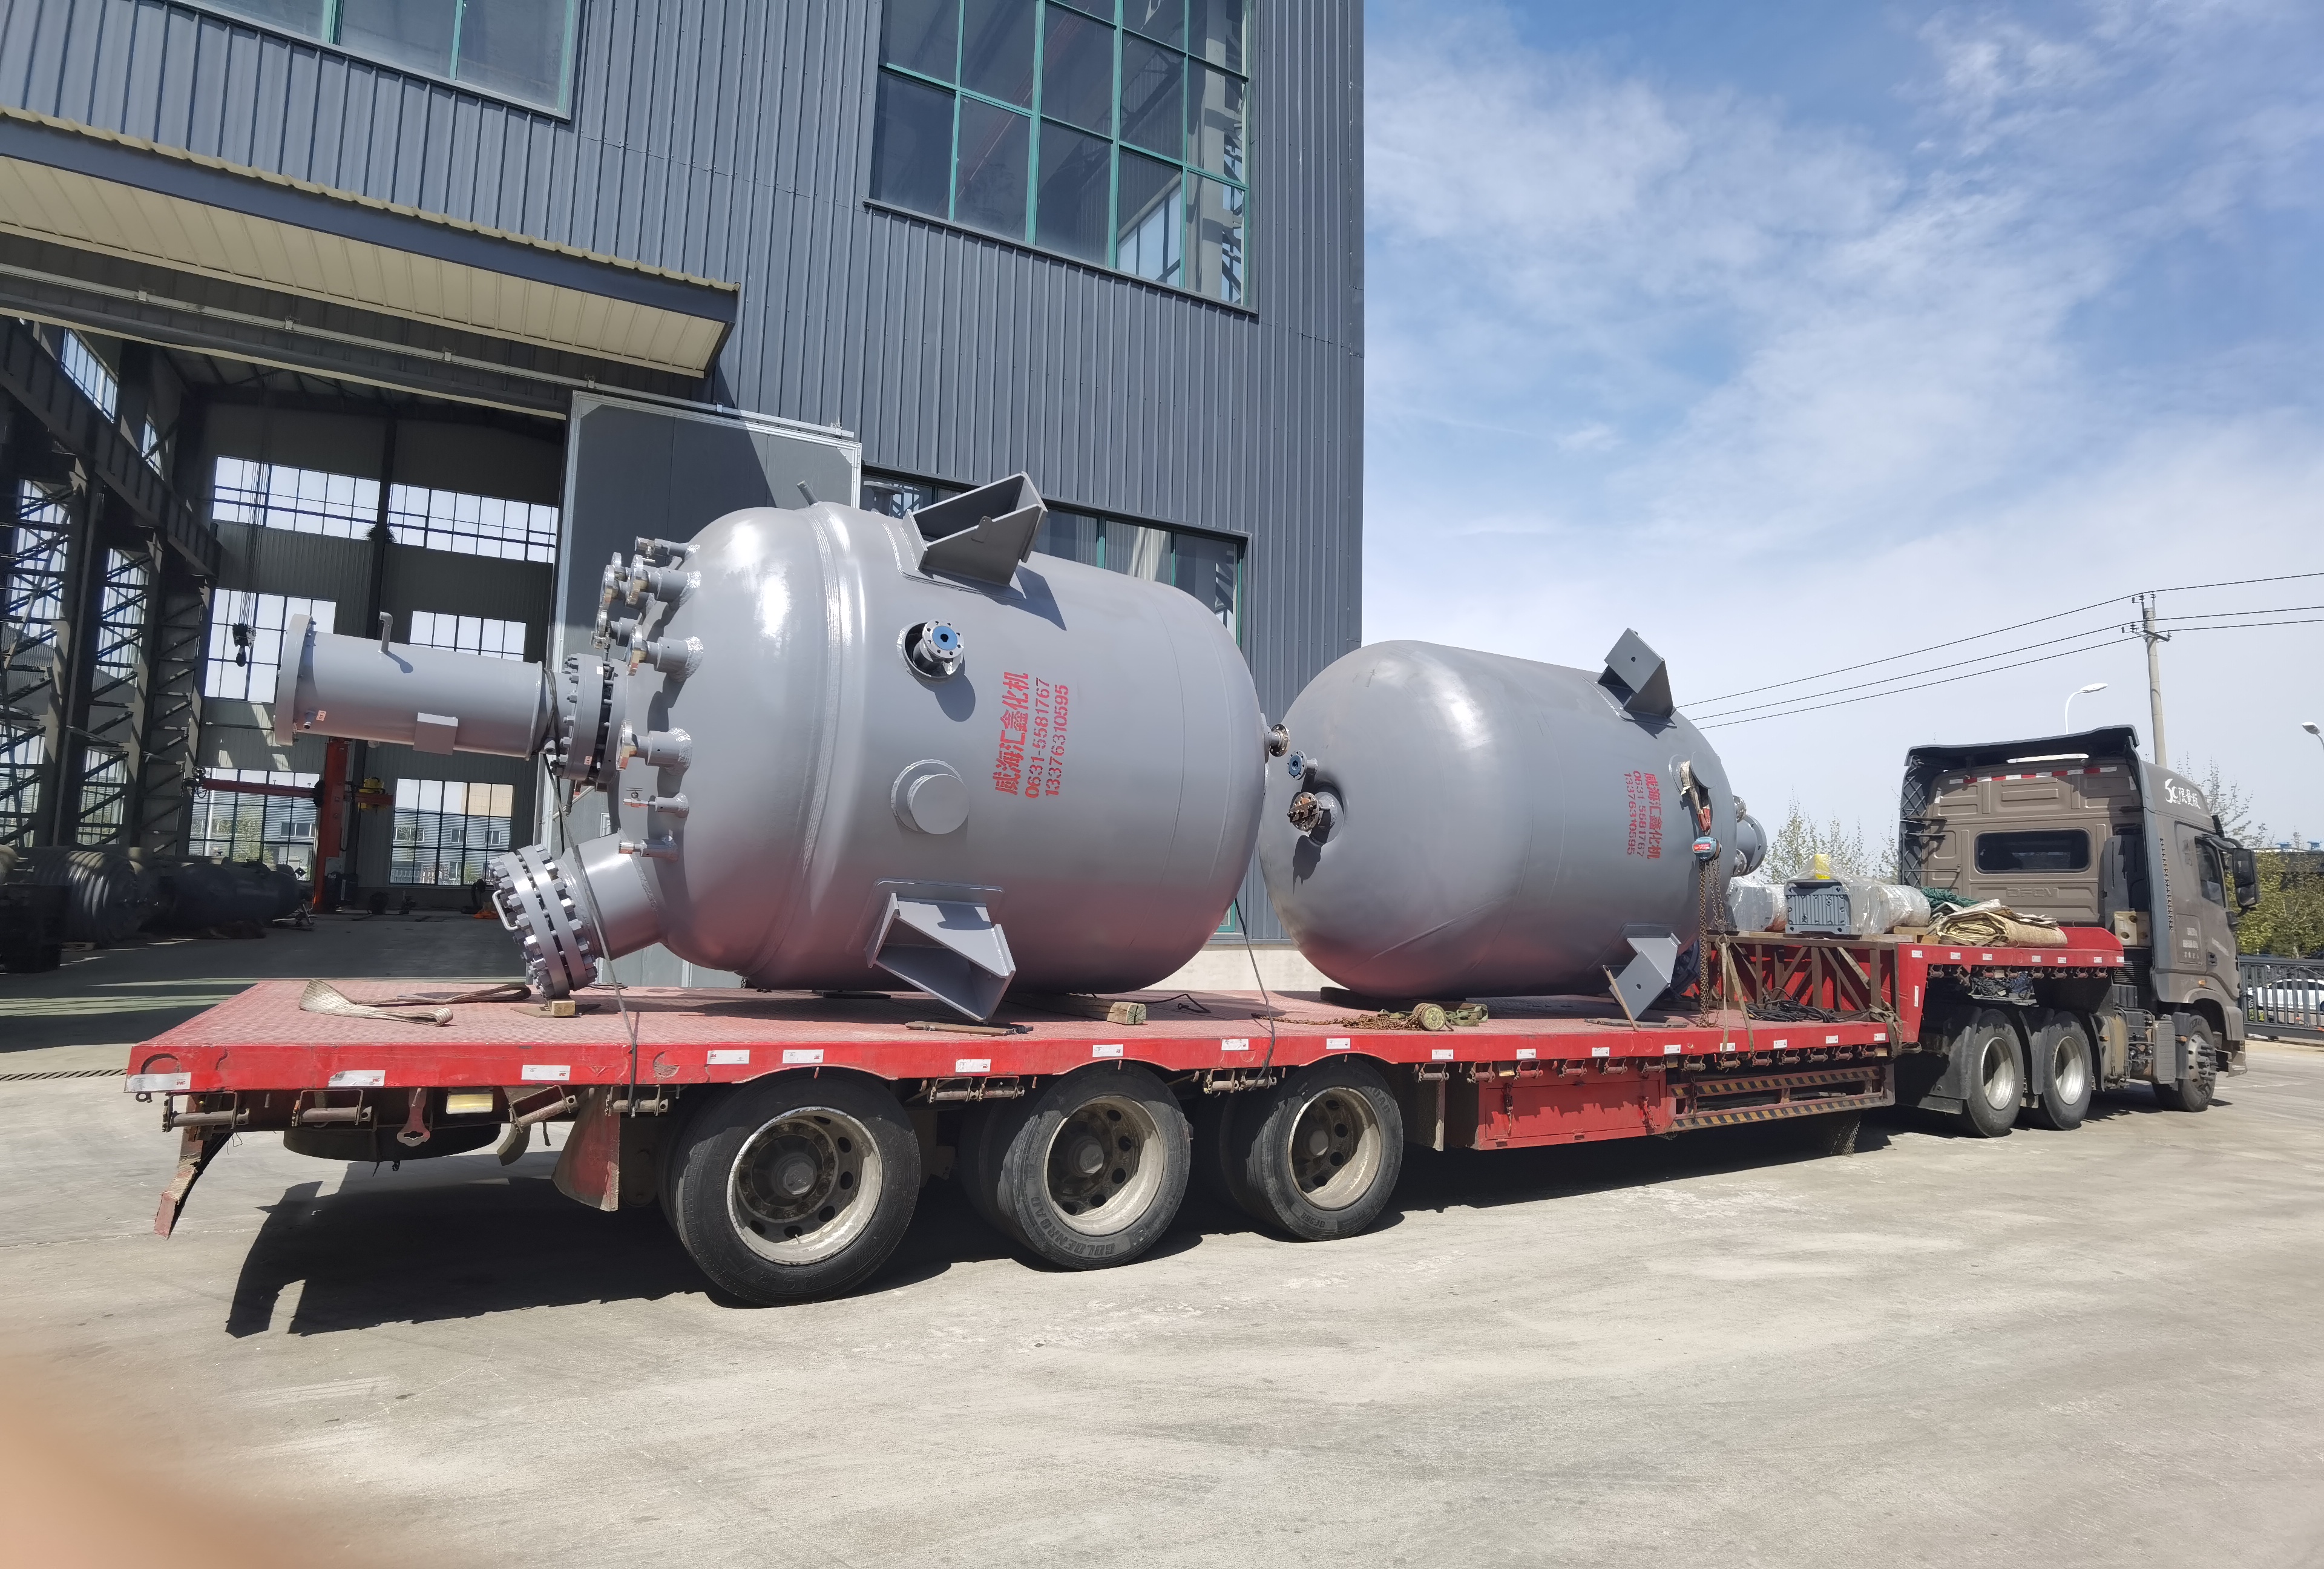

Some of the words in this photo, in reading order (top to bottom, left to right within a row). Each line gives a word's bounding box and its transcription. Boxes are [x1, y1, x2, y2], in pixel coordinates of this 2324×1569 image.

[993, 671, 1029, 795] 威海汇鑫化机
[1025, 677, 1050, 798] 0631-5581767
[1046, 684, 1069, 796] 13376310595
[1644, 772, 1663, 860] 威海汇鑫化机
[1030, 1196, 1115, 1257] GOLDENROAD
